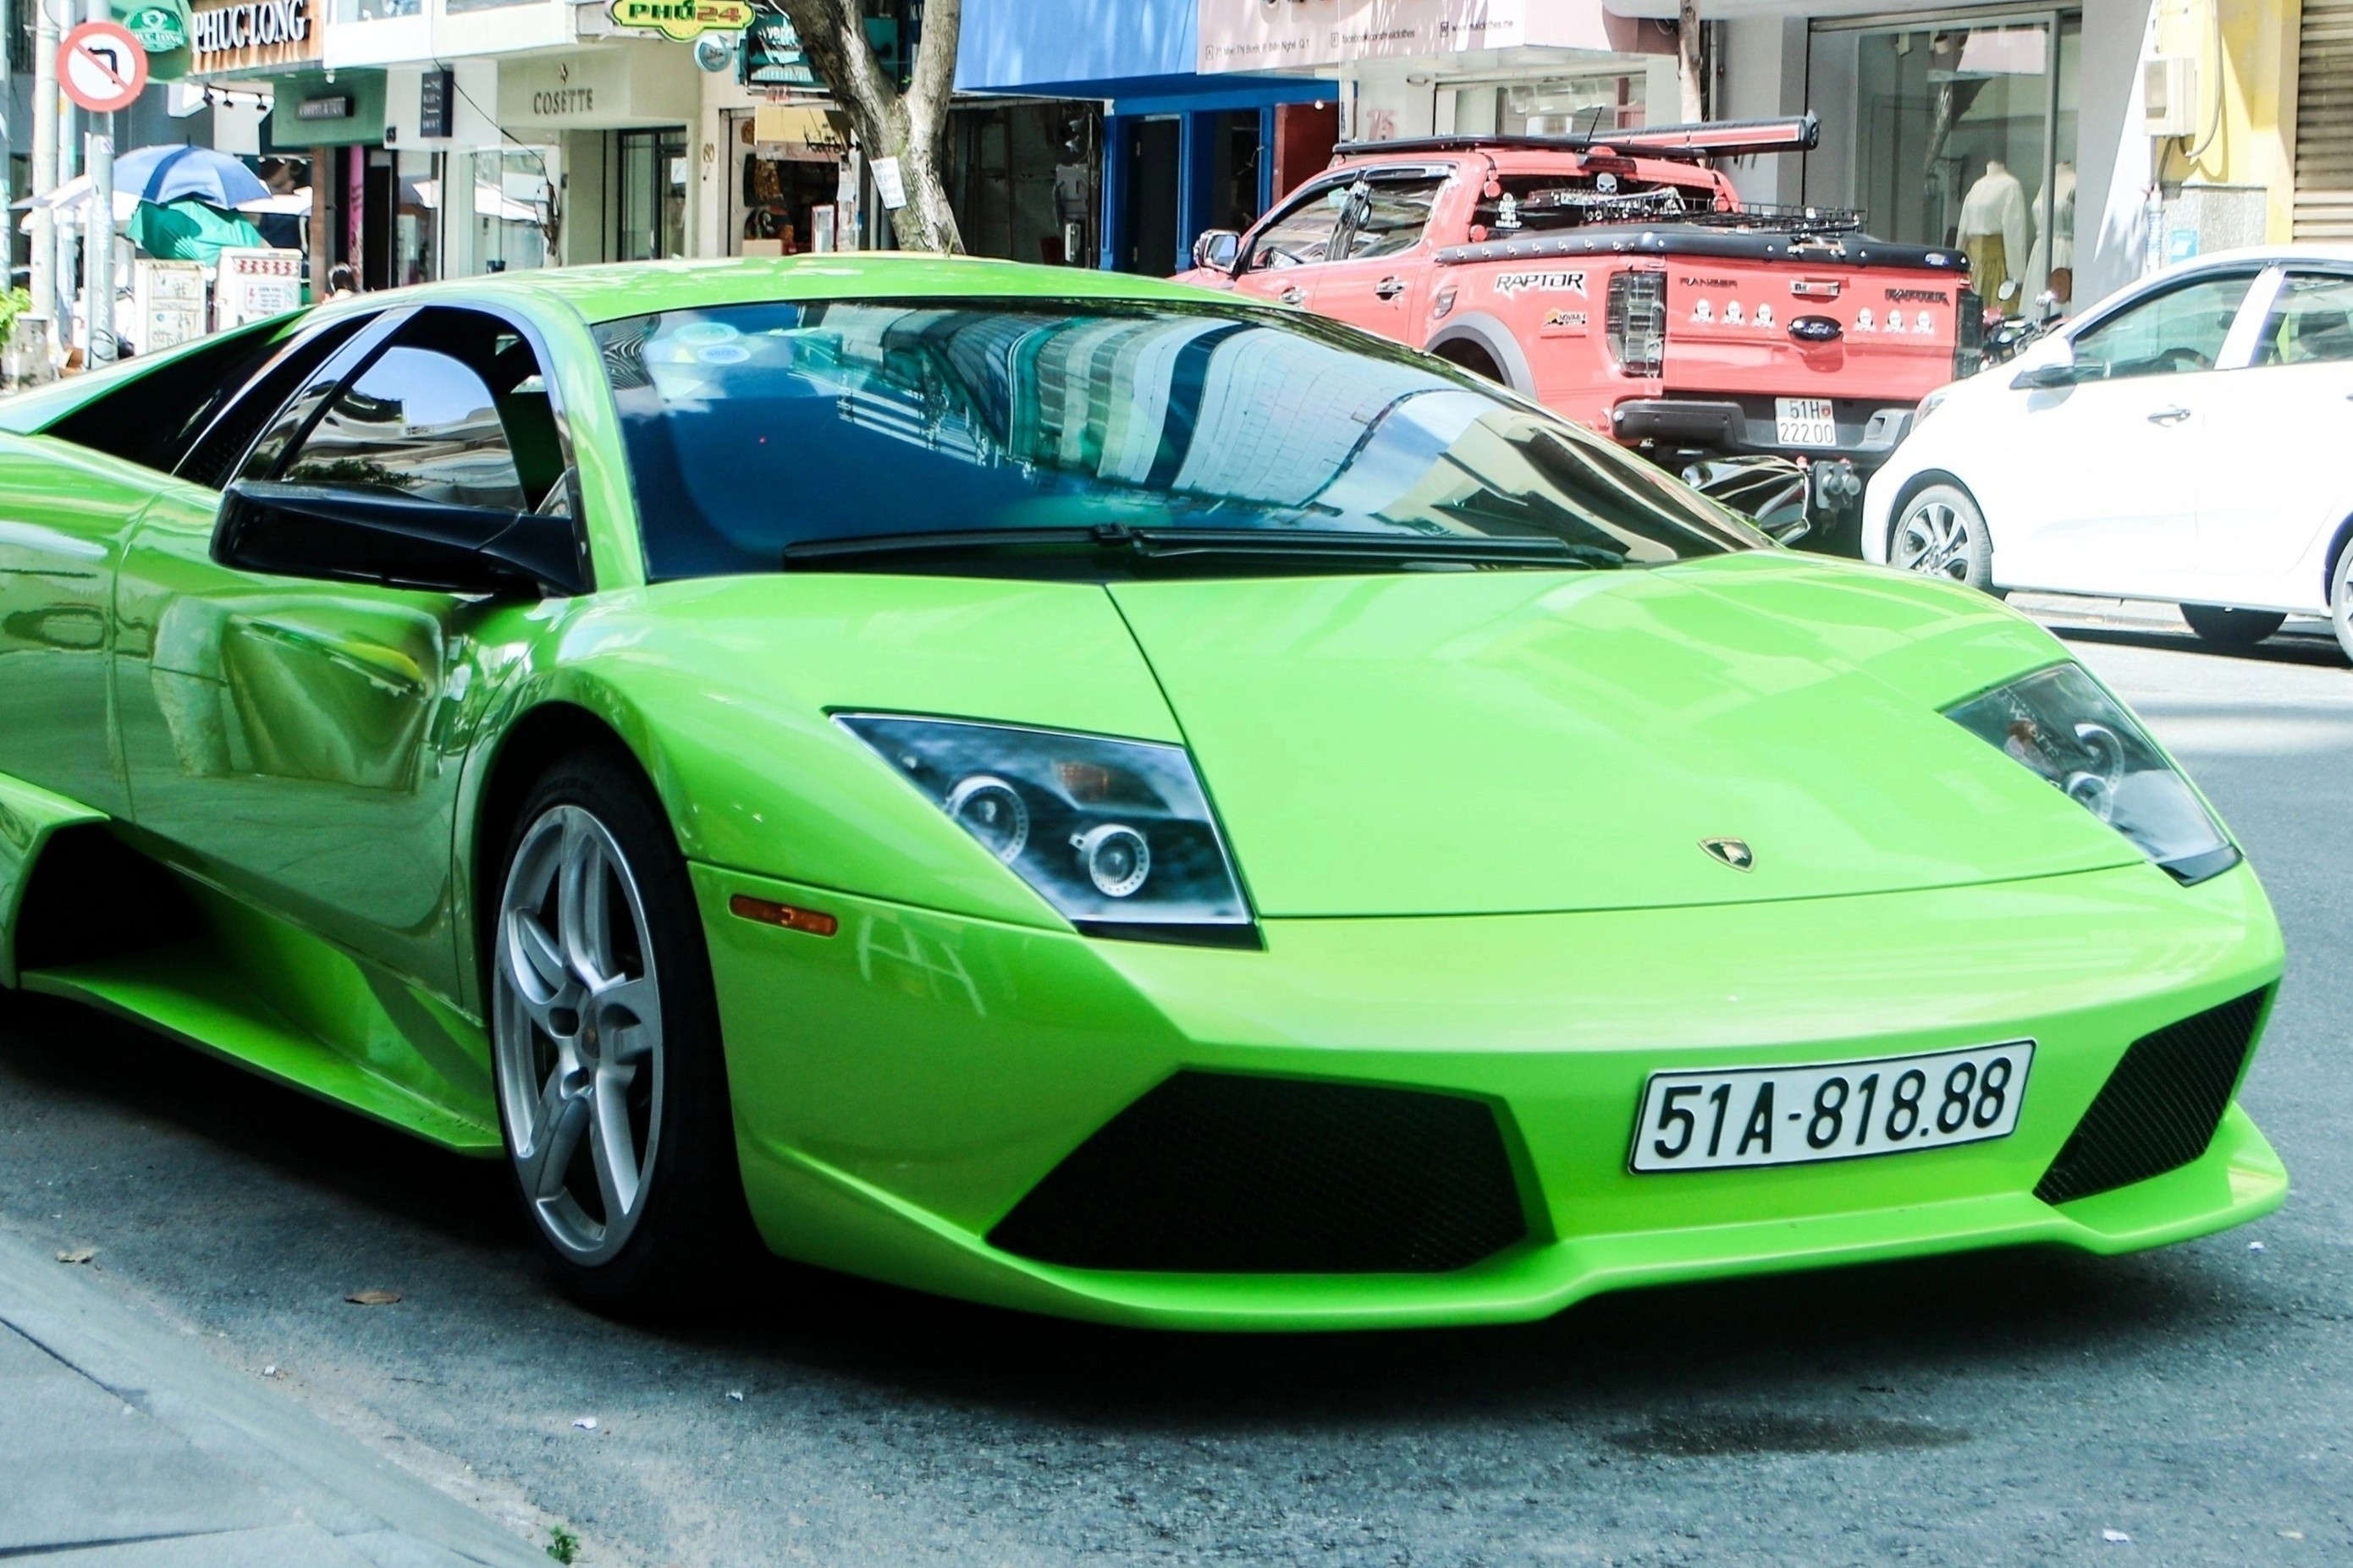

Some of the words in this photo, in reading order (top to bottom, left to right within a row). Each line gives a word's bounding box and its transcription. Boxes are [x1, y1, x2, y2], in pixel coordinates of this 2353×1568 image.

[247, 0, 308, 46] LONG
[533, 88, 593, 115] COSETTE
[1495, 272, 1585, 294] RAPTOR
[1679, 278, 1739, 289] RANGER
[1805, 322, 1829, 335] Ford
[1789, 400, 1820, 421] 51H
[1654, 1056, 2013, 1159] 51A-818.88
